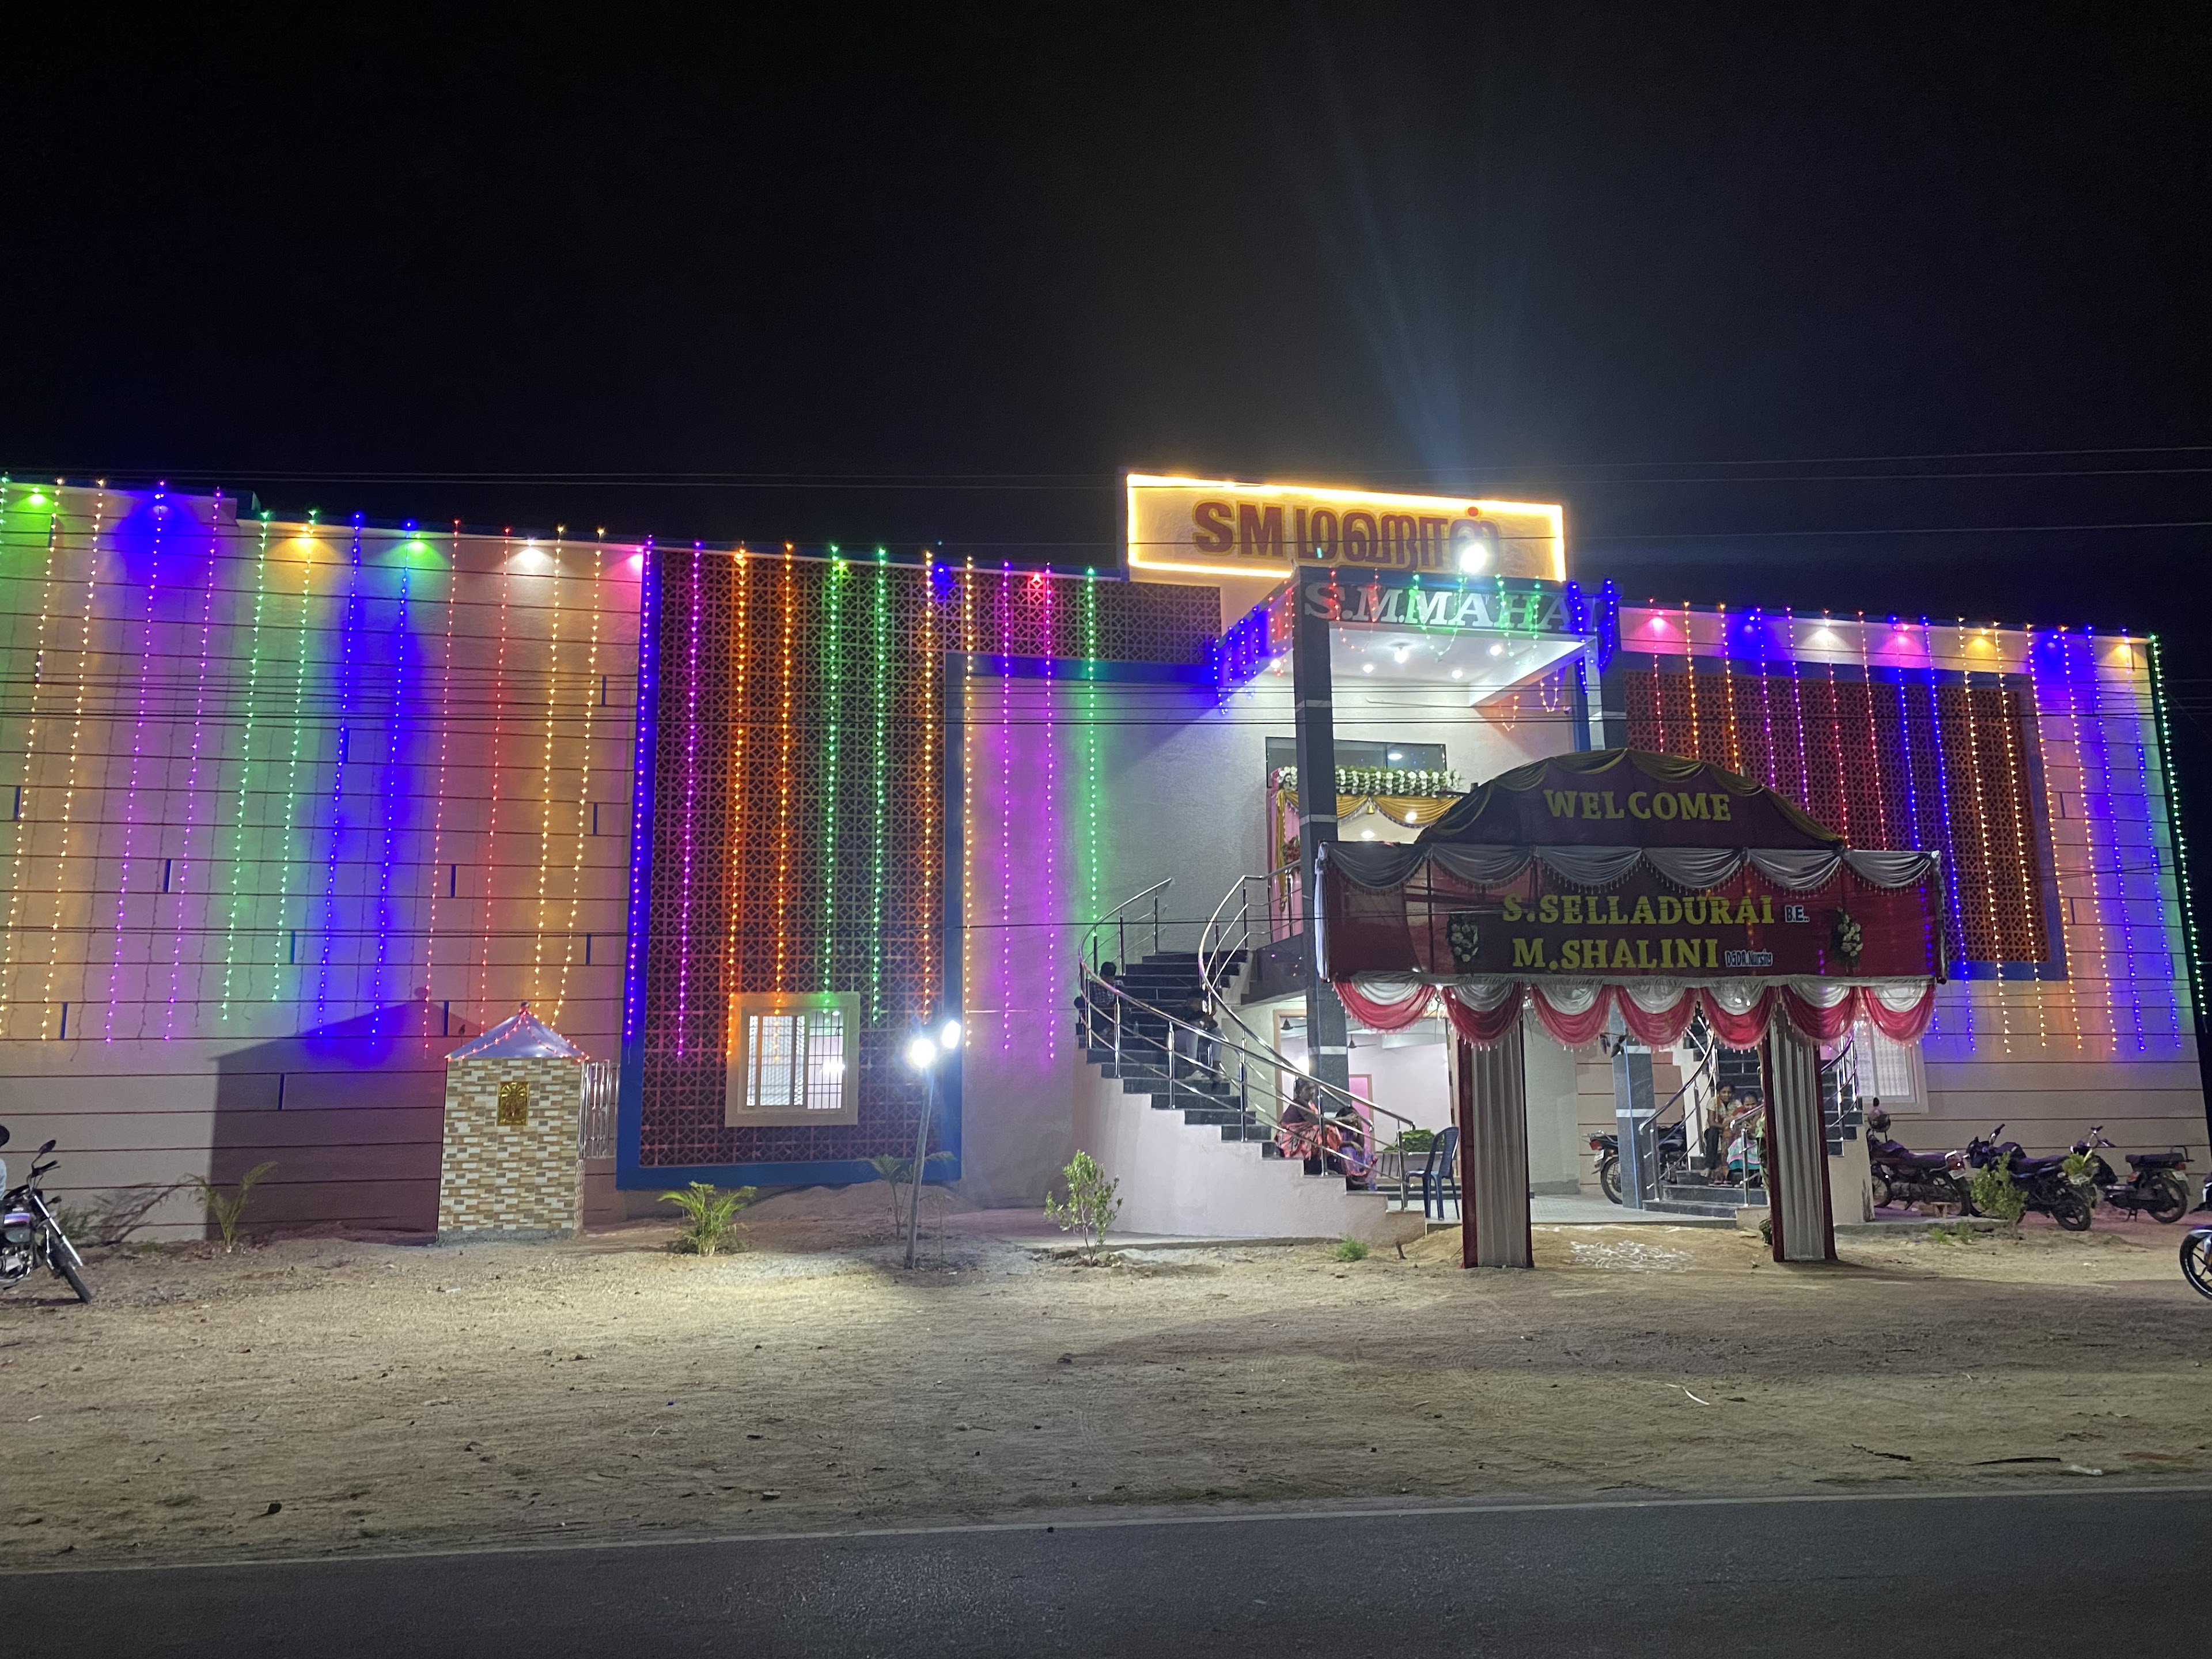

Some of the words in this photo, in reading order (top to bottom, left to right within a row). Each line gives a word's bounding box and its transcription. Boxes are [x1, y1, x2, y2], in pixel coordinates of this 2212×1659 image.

[1194, 501, 1285, 557] SM
[1543, 789, 1731, 821] WELCOME
[1502, 895, 1775, 924] S.SELLADURAI
[1512, 938, 1718, 970] M.SHALINI
